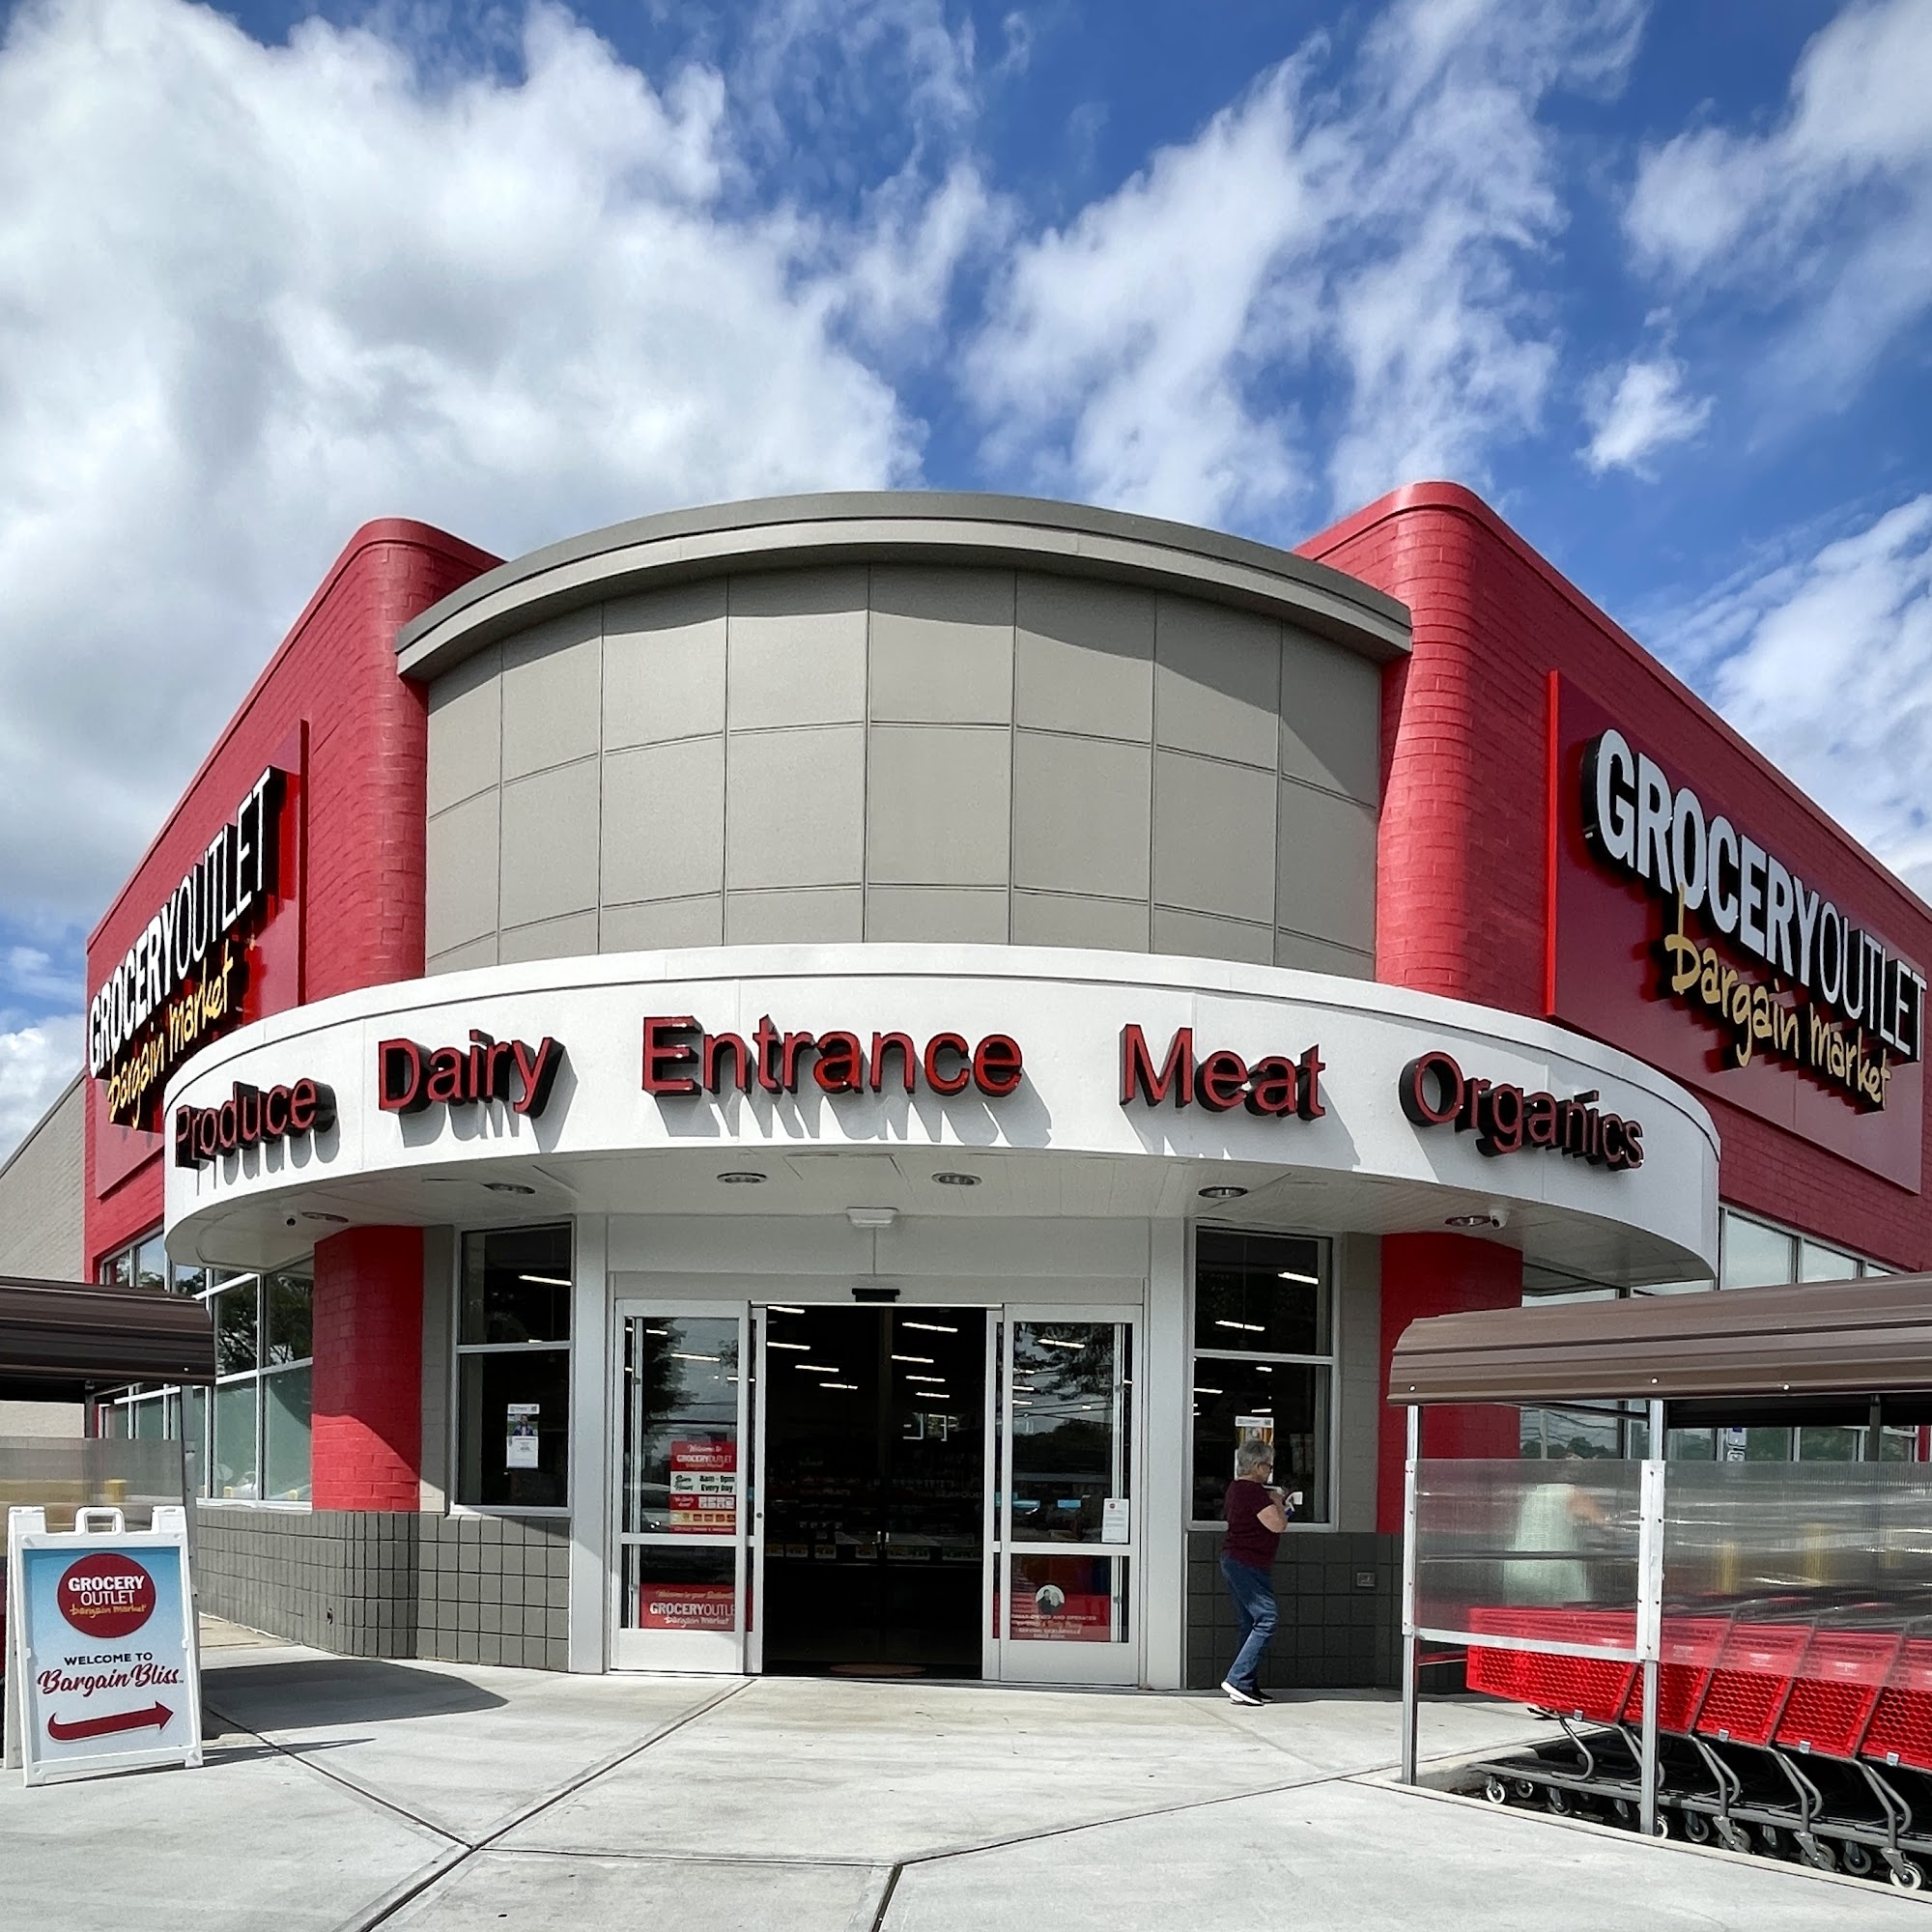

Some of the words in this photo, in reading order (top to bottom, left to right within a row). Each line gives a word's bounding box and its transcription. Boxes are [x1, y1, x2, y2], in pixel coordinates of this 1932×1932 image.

[89, 766, 270, 1079] GROCERYOUTLET
[1596, 728, 1928, 1063] GROCERYOUTLET
[107, 1022, 165, 1130] bargain
[168, 938, 235, 1063] market
[1663, 881, 1800, 1067] bargain
[1809, 1002, 1891, 1111] market
[378, 1028, 558, 1115] Dairy
[641, 1014, 1024, 1097] Entrance
[1120, 1023, 1326, 1121] Meat
[176, 1077, 318, 1168] Produce
[1402, 1050, 1645, 1171] Organics
[68, 1576, 145, 1592] GROCERY
[70, 1604, 112, 1619] bargain
[113, 1604, 147, 1614] market
[80, 1589, 135, 1606] OUTLET
[37, 1668, 132, 1698] Bargain
[130, 1662, 180, 1688] Bliss
[64, 1653, 132, 1666] WELCOME
[134, 1652, 154, 1662] TO
